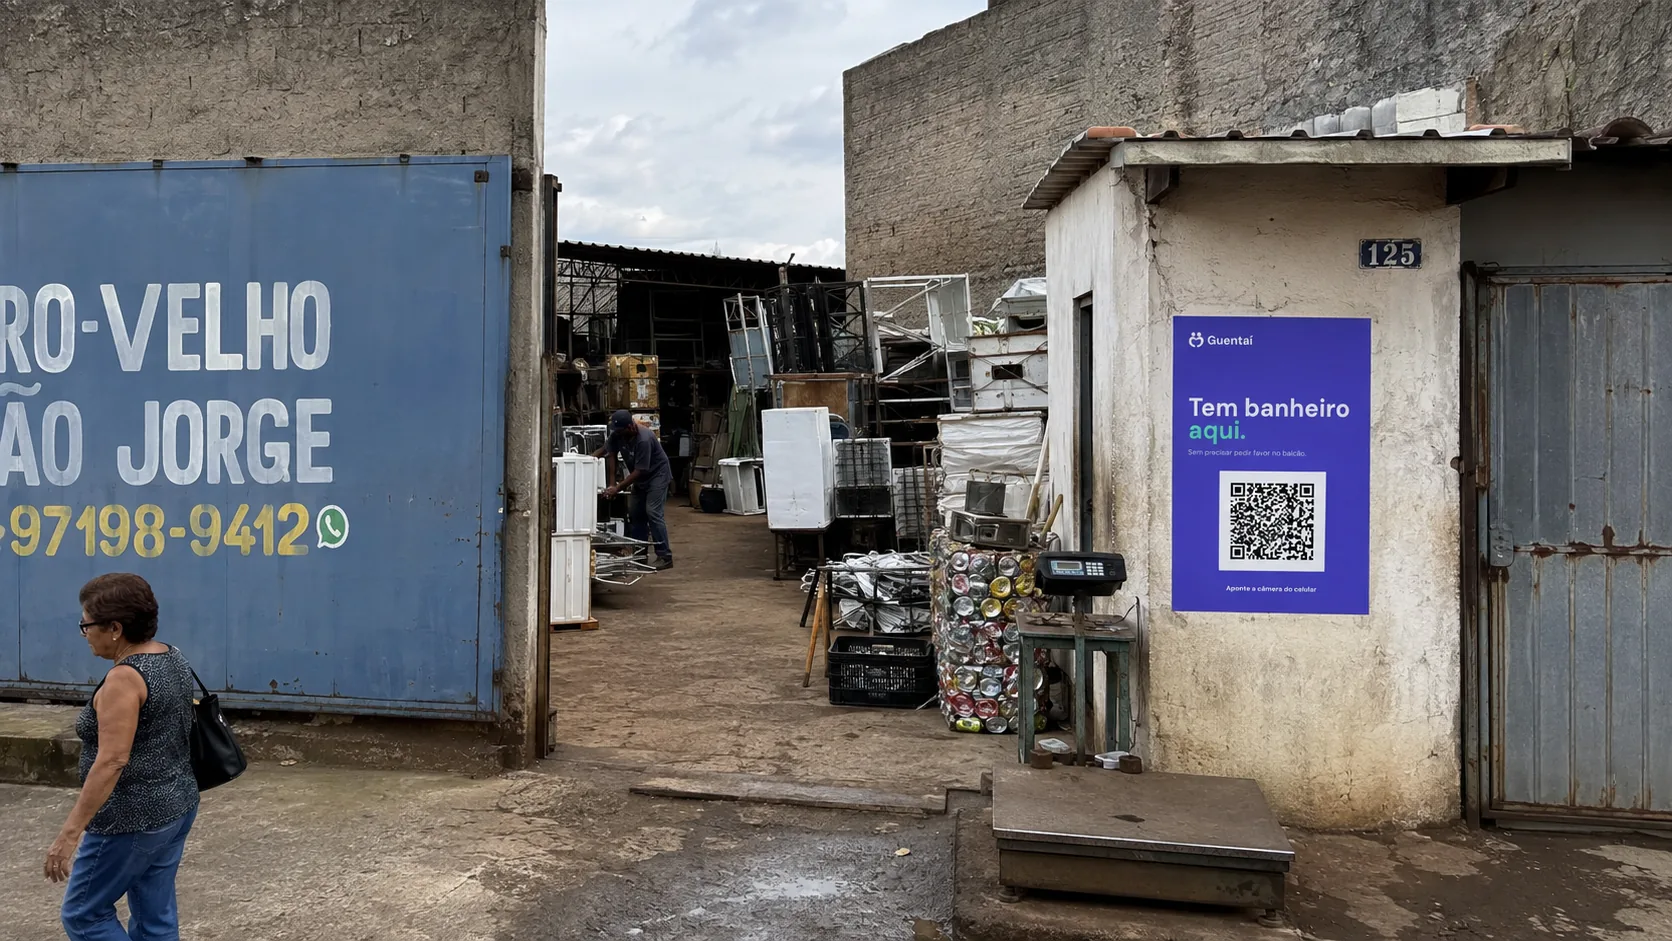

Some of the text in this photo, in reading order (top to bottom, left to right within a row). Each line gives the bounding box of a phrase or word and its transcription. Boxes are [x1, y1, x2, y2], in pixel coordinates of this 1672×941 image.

[1368, 243, 1415, 266] 125
[0, 281, 331, 373] RO-VELHO
[1207, 335, 1253, 346] Guentaí
[1189, 397, 1350, 418] Tem banheiro
[0, 382, 333, 486] ÃO JORGE
[1189, 420, 1246, 445] aqui.
[0, 503, 309, 557] 97198-9412
